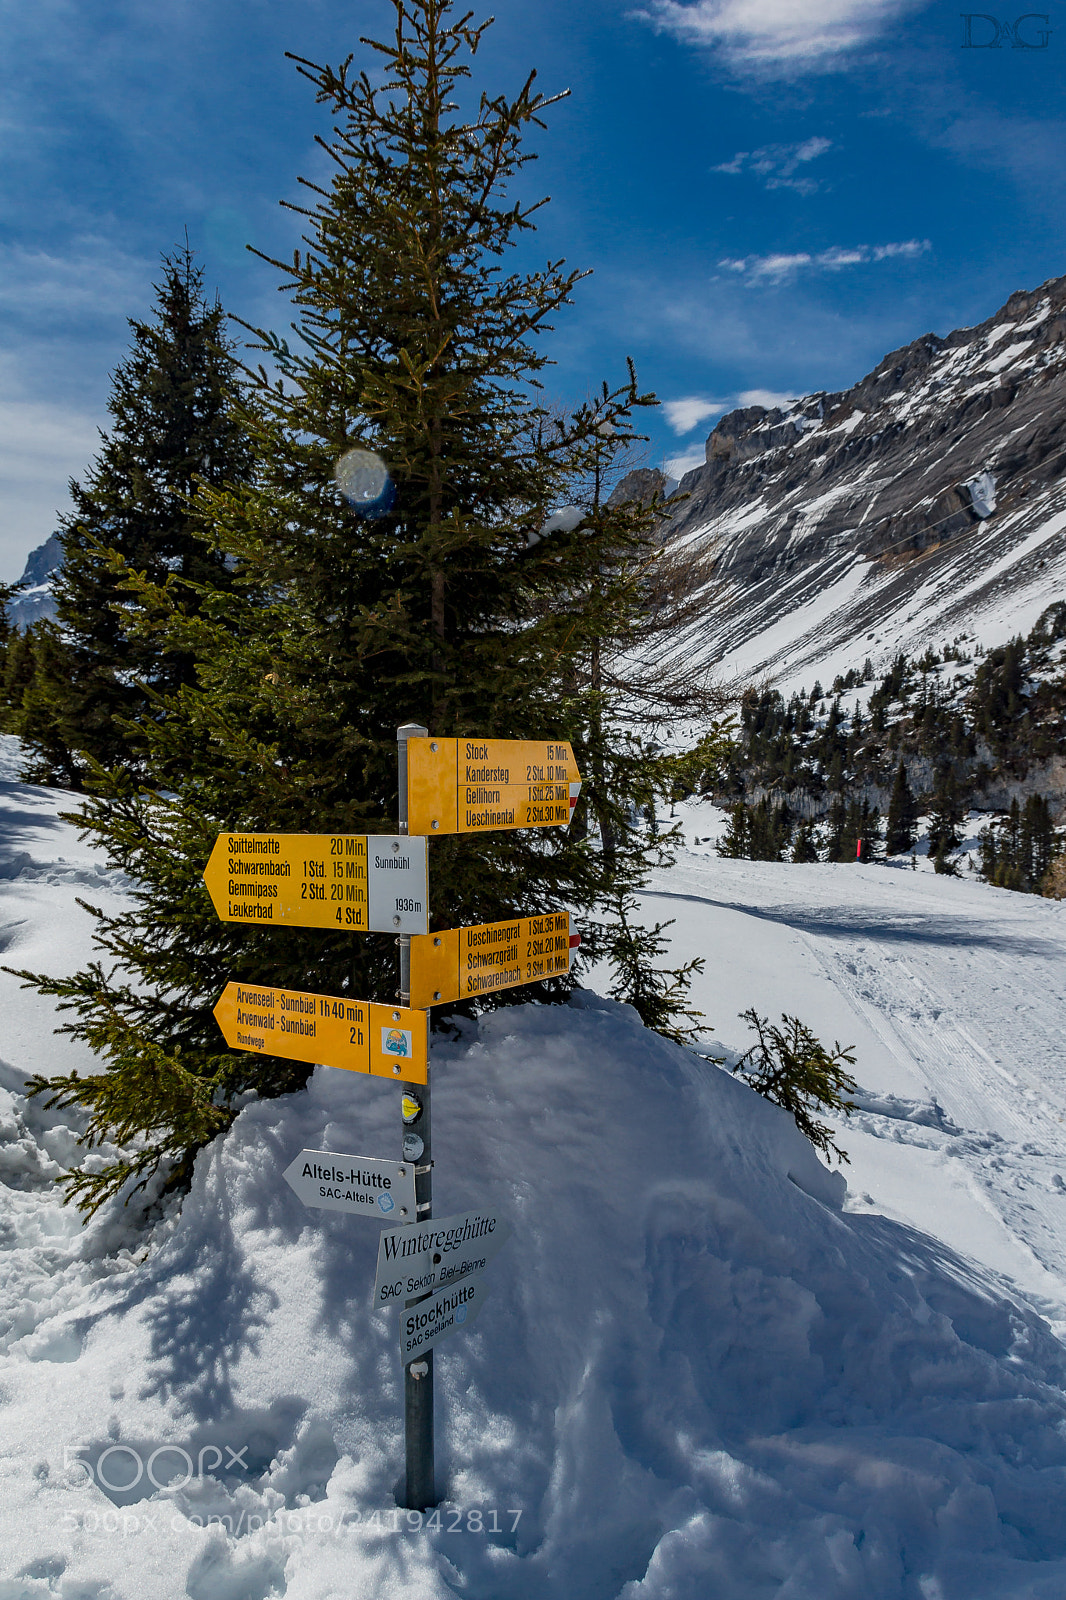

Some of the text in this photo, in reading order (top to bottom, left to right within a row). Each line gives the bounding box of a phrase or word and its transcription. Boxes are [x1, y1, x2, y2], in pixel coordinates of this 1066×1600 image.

[466, 743, 568, 760] Stock 15 Min.
[466, 766, 568, 784] Kandersteg 2 Std. 10 Min.
[466, 787, 500, 804] Gellihorn
[528, 787, 531, 801] 1
[555, 786, 568, 800] Min.
[466, 808, 514, 826] Ueschinental
[527, 807, 531, 822] 2
[555, 806, 568, 820] Min.
[228, 837, 366, 856] Spittelmatte 20 Min.
[228, 858, 366, 879] Schwarenbach 1 Std. 15 Min.
[375, 856, 410, 870] Sunnbühl
[228, 880, 366, 902] Gemmipass 2 Std. 20 Min.
[228, 901, 364, 925] Leukerbad 4 Std.
[468, 923, 520, 947] Ueschinengrat
[528, 921, 531, 936] 1
[555, 916, 567, 931] Min.
[468, 944, 518, 970] Schwarzgrätli
[527, 942, 531, 957] 2
[555, 936, 567, 950] Min.
[468, 965, 520, 992] Schwarenbach
[555, 956, 567, 971] Min.
[332, 1002, 344, 1019] 40
[346, 1005, 363, 1023] min
[237, 1032, 265, 1050] Rundwege
[350, 1027, 356, 1044] 2
[302, 1163, 392, 1189] Altels-Hütte
[320, 1187, 374, 1204] SAC-Altels
[384, 1217, 496, 1262] Winteregghütte
[380, 1282, 402, 1300] SAC
[407, 1273, 435, 1292] Sektion
[406, 1286, 475, 1335] Stockhütte
[406, 1315, 454, 1351] SAC Seeland
